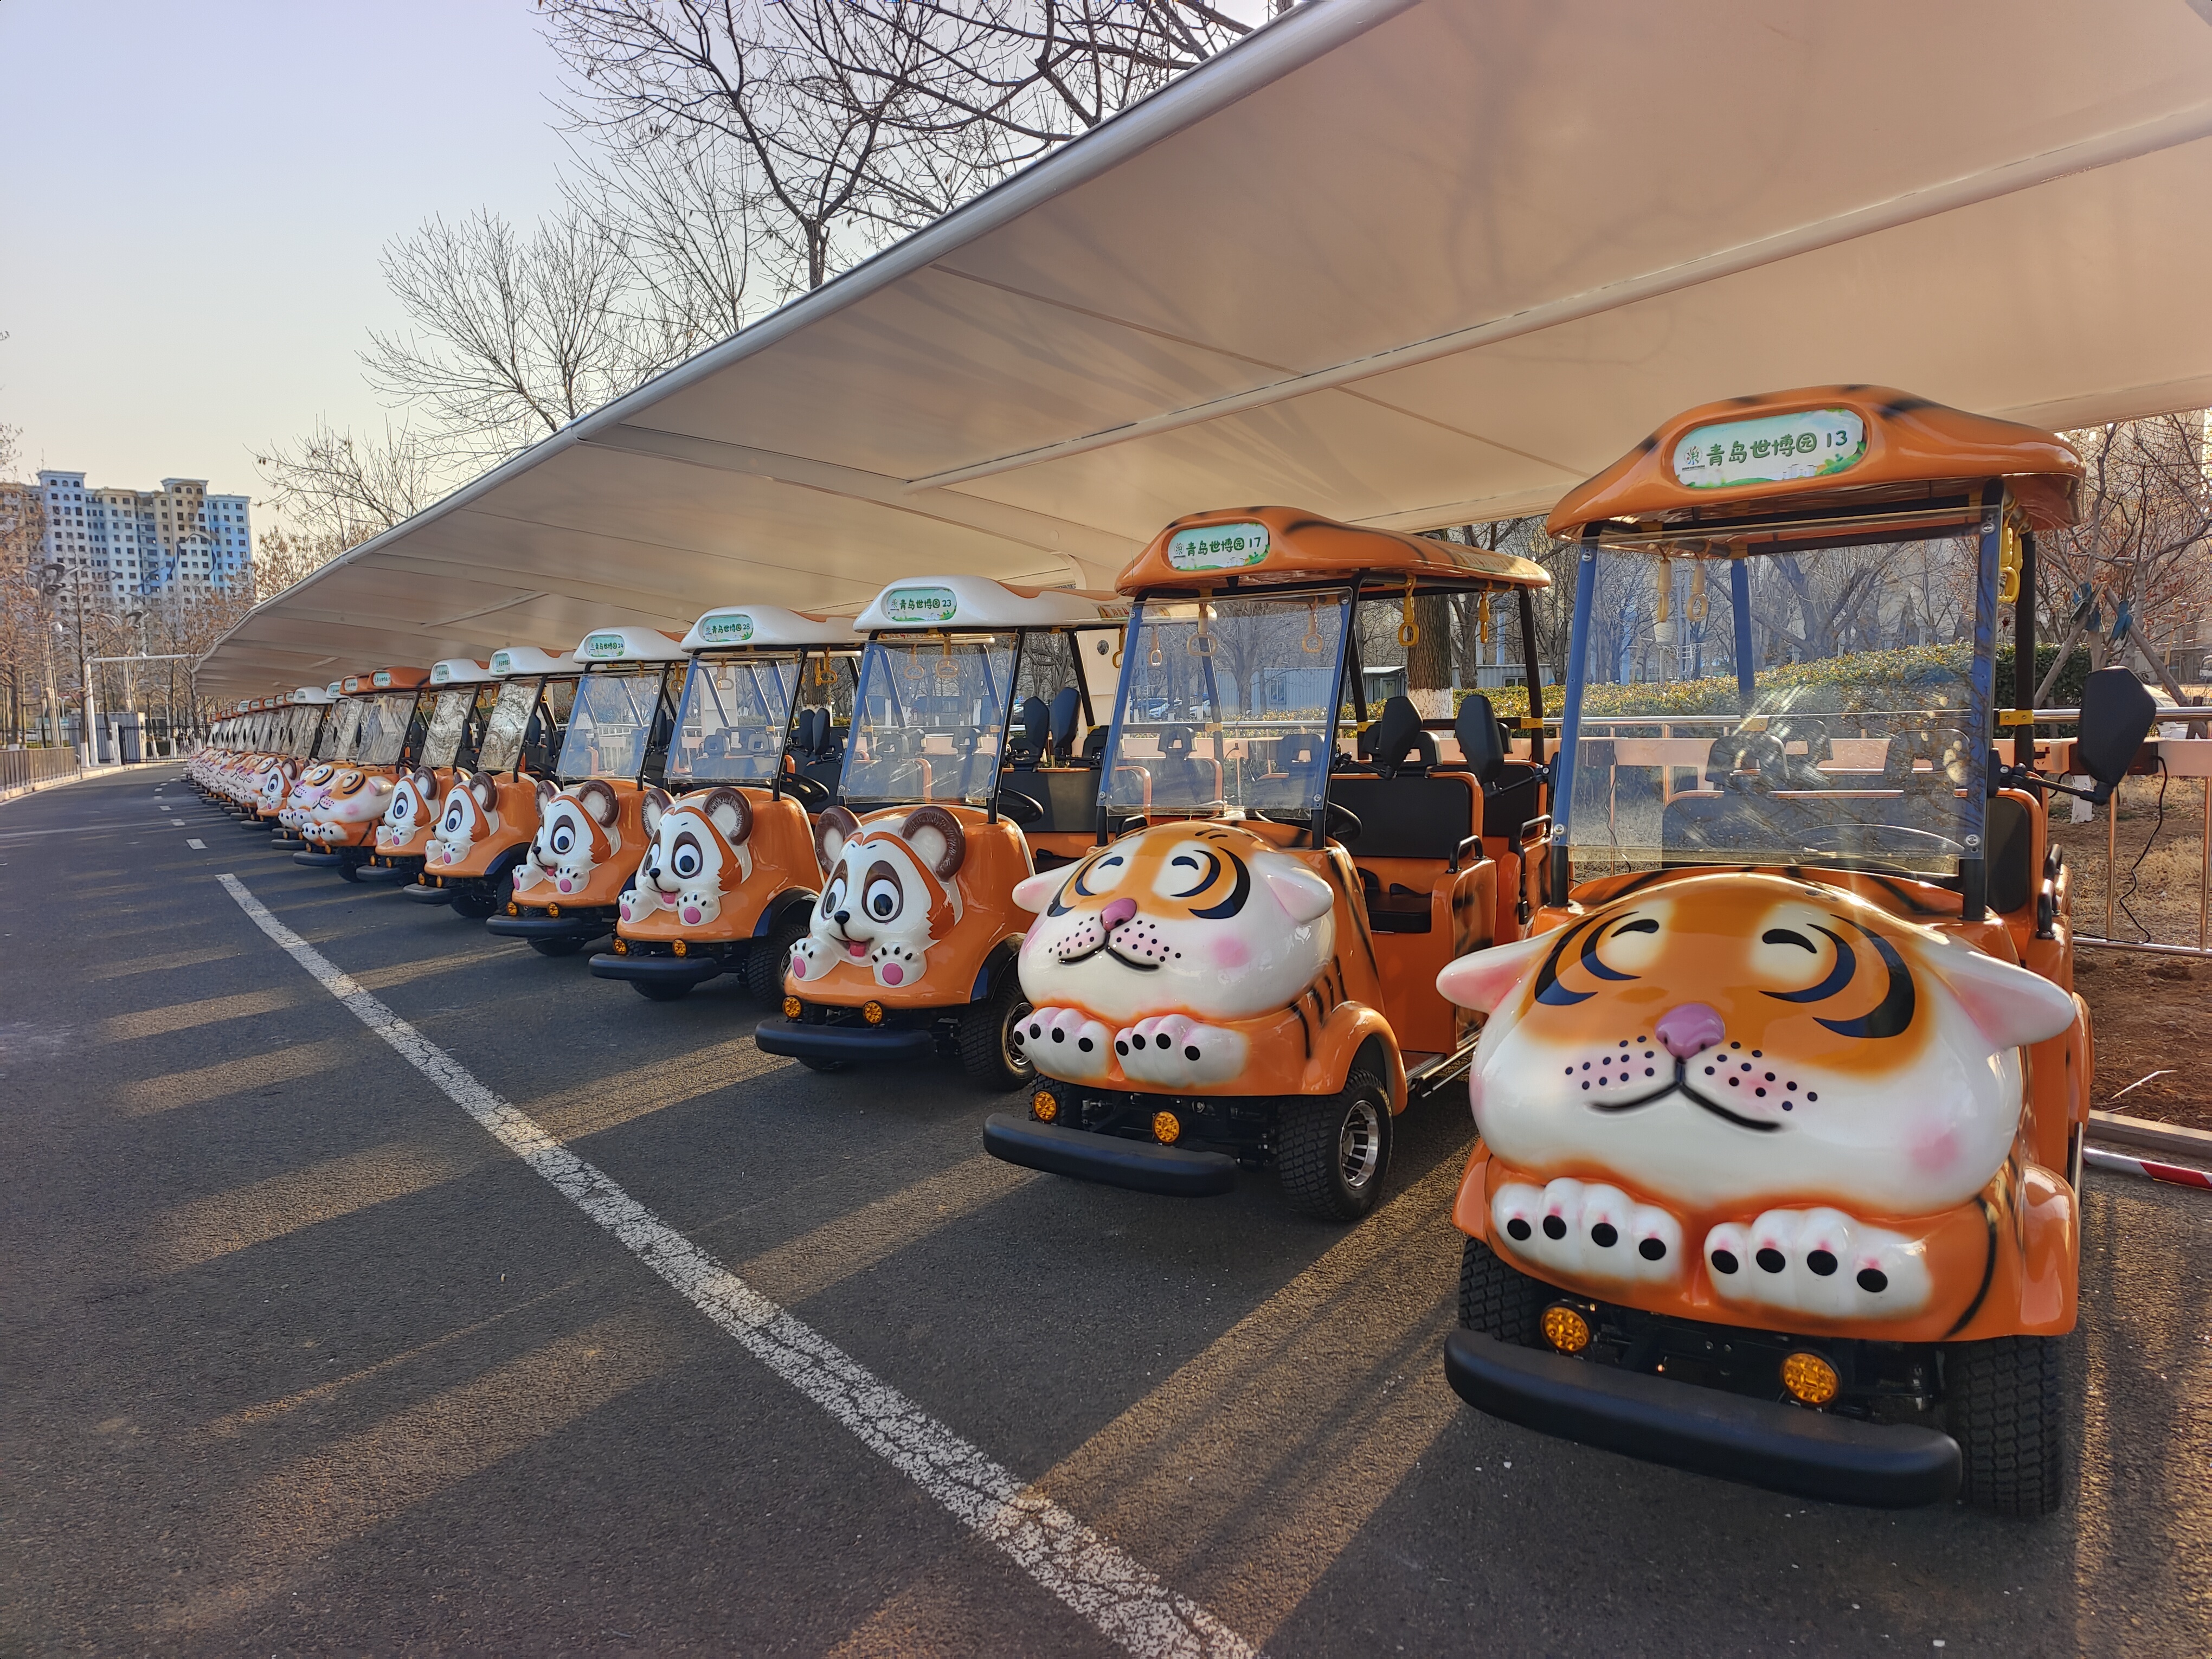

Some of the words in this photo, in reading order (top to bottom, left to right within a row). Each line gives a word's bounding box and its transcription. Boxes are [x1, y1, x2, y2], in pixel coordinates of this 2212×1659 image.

[1706, 432, 1817, 467] 青岛世博园
[1826, 429, 1848, 448] 13
[1186, 537, 1245, 557] 青岛世博园
[1249, 536, 1261, 548] 17
[899, 598, 941, 610] 青岛世博园
[942, 599, 951, 607] 23
